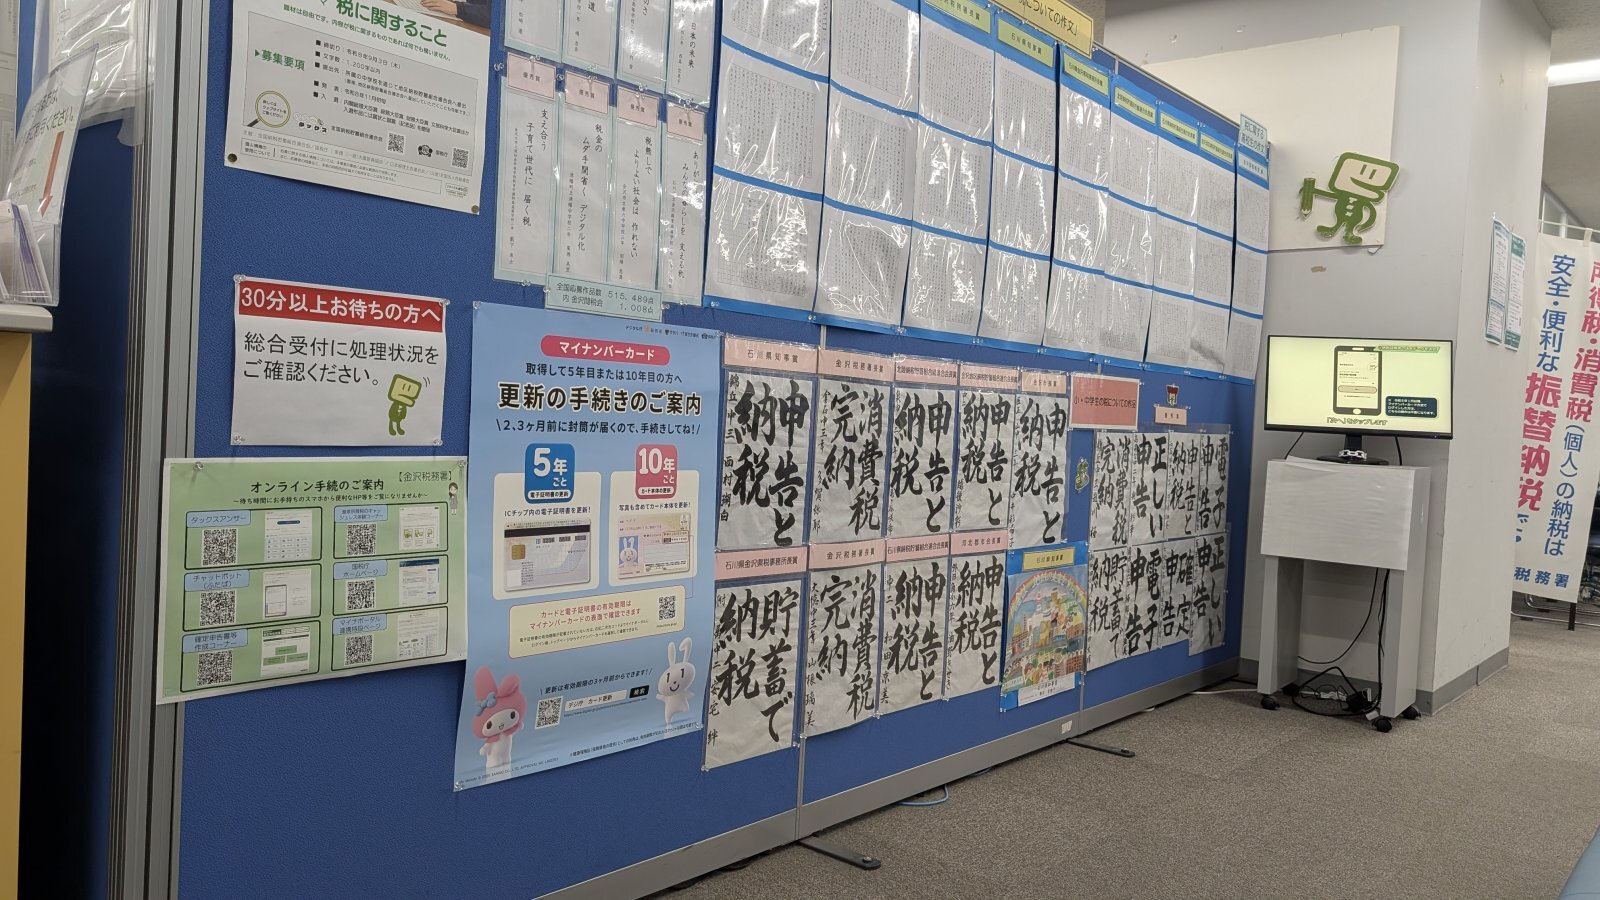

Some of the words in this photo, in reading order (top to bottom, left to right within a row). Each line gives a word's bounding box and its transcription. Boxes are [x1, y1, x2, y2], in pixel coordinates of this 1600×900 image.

[263, 50, 306, 72] 募集要項
[336, 0, 448, 47] 税に関すること
[241, 287, 440, 324] 30分以上お待ちの方へ
[243, 331, 440, 366] 総合受付に処理状況を
[559, 341, 656, 361] マイナンバーカード
[243, 358, 378, 387] ご確認ください。
[497, 381, 702, 416] 更新の手続きのご案内
[525, 362, 683, 389] 取得して5年目または10年目の方へ
[747, 349, 799, 364] 石川県知事賞
[398, 471, 452, 483] 【金沢税務署】
[732, 379, 777, 508] 納税
[769, 379, 810, 547] 申告と
[822, 382, 860, 490] 完納
[849, 387, 884, 536] 消費税
[890, 392, 926, 498] 納税
[924, 391, 952, 533] 申告と
[962, 392, 989, 484] 納税
[986, 394, 1011, 526] 申告と
[1014, 398, 1045, 498] 納税
[1040, 402, 1067, 544] 申告と
[1096, 436, 1116, 510] 完納
[1133, 433, 1153, 518] 申告
[1169, 440, 1187, 511] 納税
[190, 514, 247, 524] タックスアンサー
[250, 478, 385, 495] オンライン手続のご案内
[530, 490, 571, 500] 電子証明書の更新
[640, 487, 672, 495] カード本体の更新
[1112, 435, 1132, 545] 消費税
[1149, 435, 1167, 538] 正しい
[1184, 439, 1199, 535] 申告と
[1199, 435, 1214, 533] 申告
[1212, 436, 1229, 529] 電子
[193, 572, 242, 582] チャットボット
[343, 569, 379, 577] ホームページ
[540, 600, 632, 620] カードと電子証明書の有効期限は
[952, 560, 986, 655] 納税
[1090, 552, 1111, 633] 納税
[1110, 550, 1128, 658] 貯蓄で
[1125, 546, 1148, 656] 申告
[1143, 548, 1161, 652] 電子
[1162, 549, 1179, 637] 申告
[1175, 548, 1194, 638] 確定
[1193, 537, 1212, 618] 申告
[1209, 536, 1226, 647] 正しい
[1513, 566, 1569, 588] 税務署
[194, 641, 238, 651] 作成コーナー
[529, 607, 642, 631] マイナンバーカードの表面で確認できます
[716, 588, 760, 706] 納税
[758, 586, 800, 743] 貯蓄で
[816, 574, 853, 681] 完納
[846, 568, 877, 720] 消費税
[887, 566, 924, 675] 納税
[918, 561, 947, 701] 申告と
[980, 555, 1004, 685] 申告と
